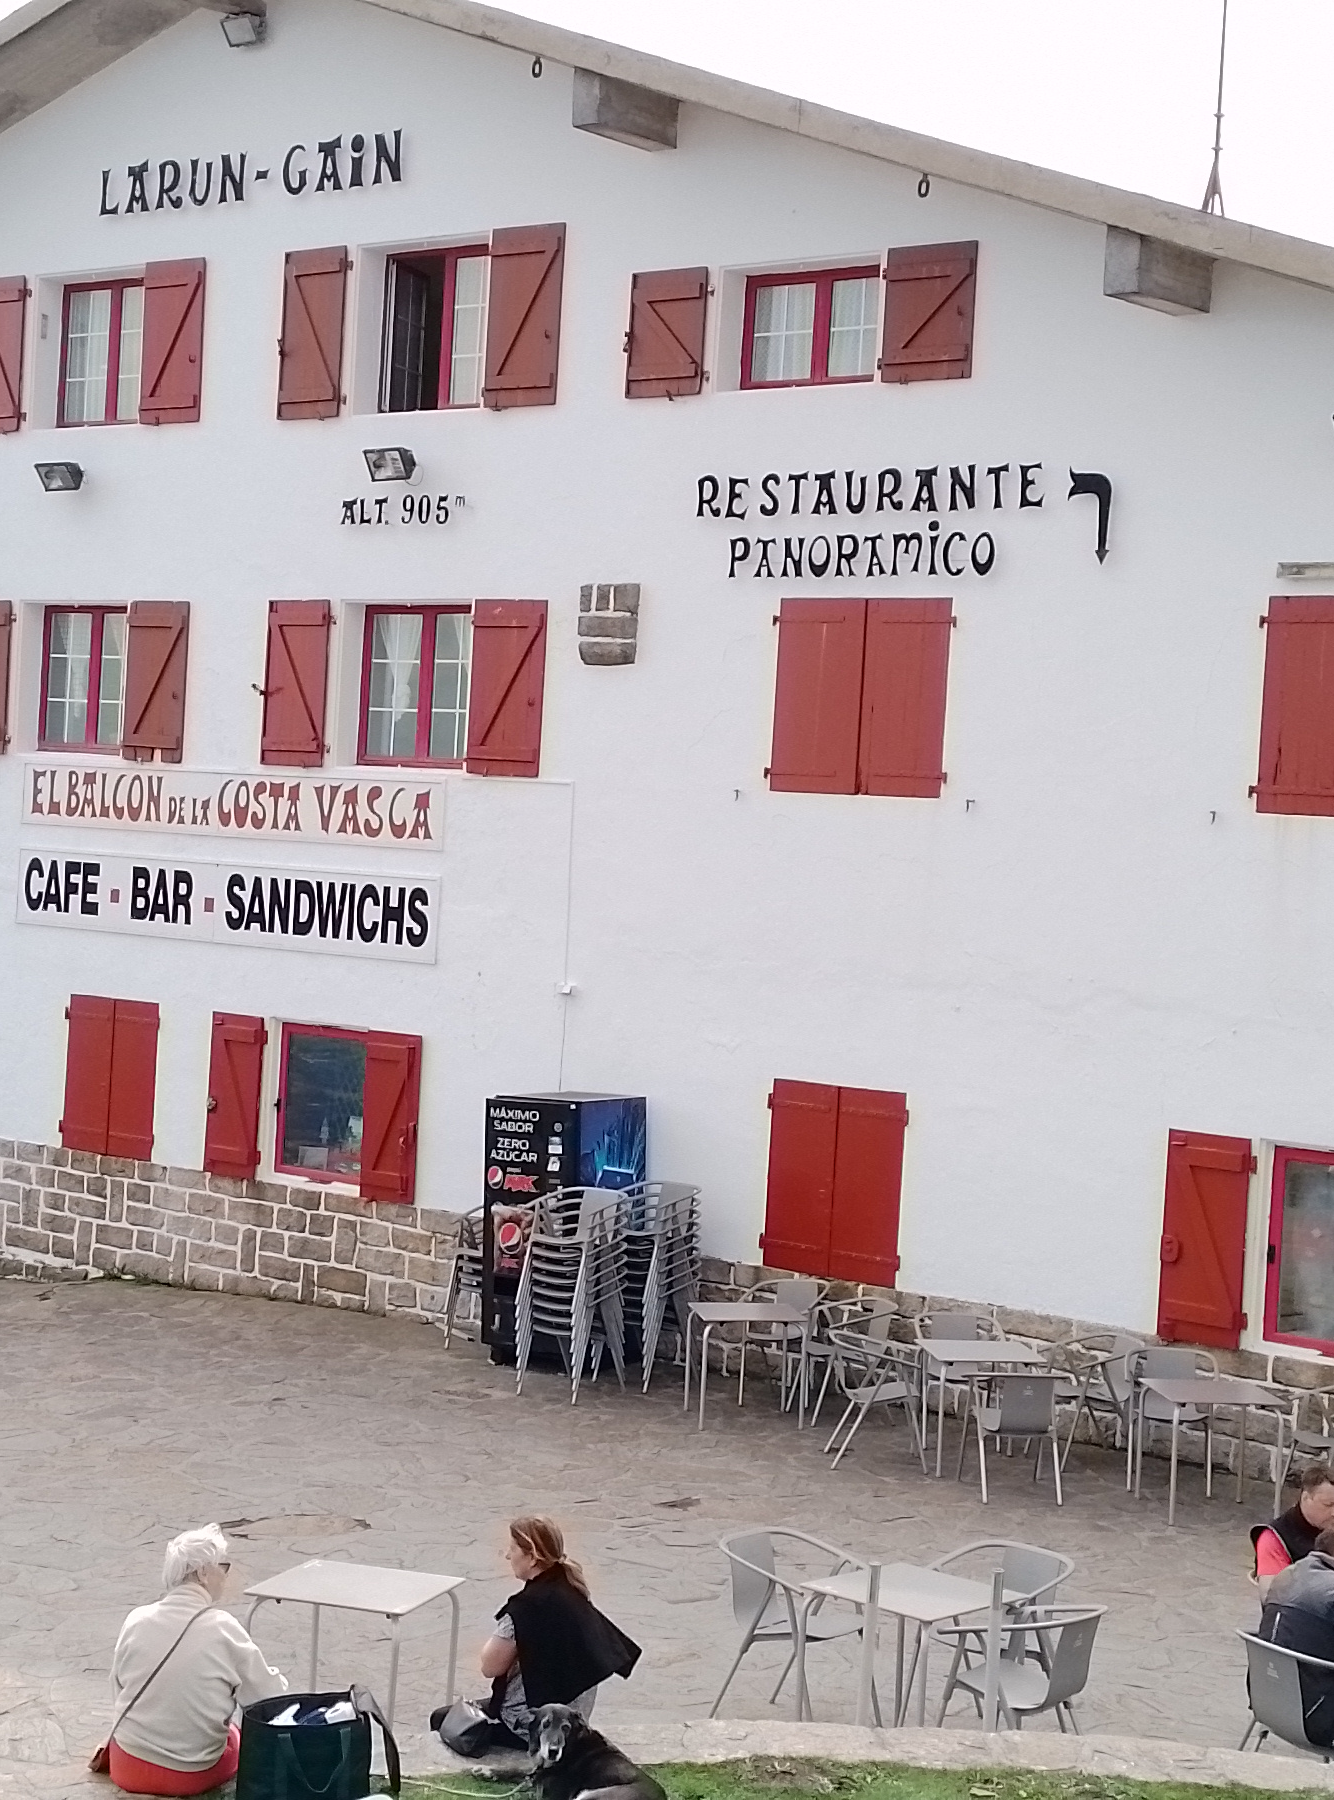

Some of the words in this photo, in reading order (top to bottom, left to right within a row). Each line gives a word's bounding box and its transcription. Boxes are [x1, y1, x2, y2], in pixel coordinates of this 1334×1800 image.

[696, 462, 1045, 520] RESTAURANTE
[340, 496, 390, 526] ALT.
[31, 769, 61, 816] EL
[64, 769, 164, 823] BALCON
[167, 795, 187, 825] DE
[190, 796, 210, 827] LA
[217, 778, 302, 832] COSTA
[313, 783, 434, 841] VASCA
[24, 856, 101, 916] CAFE
[130, 865, 194, 925] BAR
[224, 873, 430, 948] SANDWICHS
[489, 1106, 540, 1121] MÁXIMO
[493, 1119, 534, 1133] SABOR
[496, 1136, 530, 1150] ZERO
[489, 1148, 538, 1163] AZÚCAR
